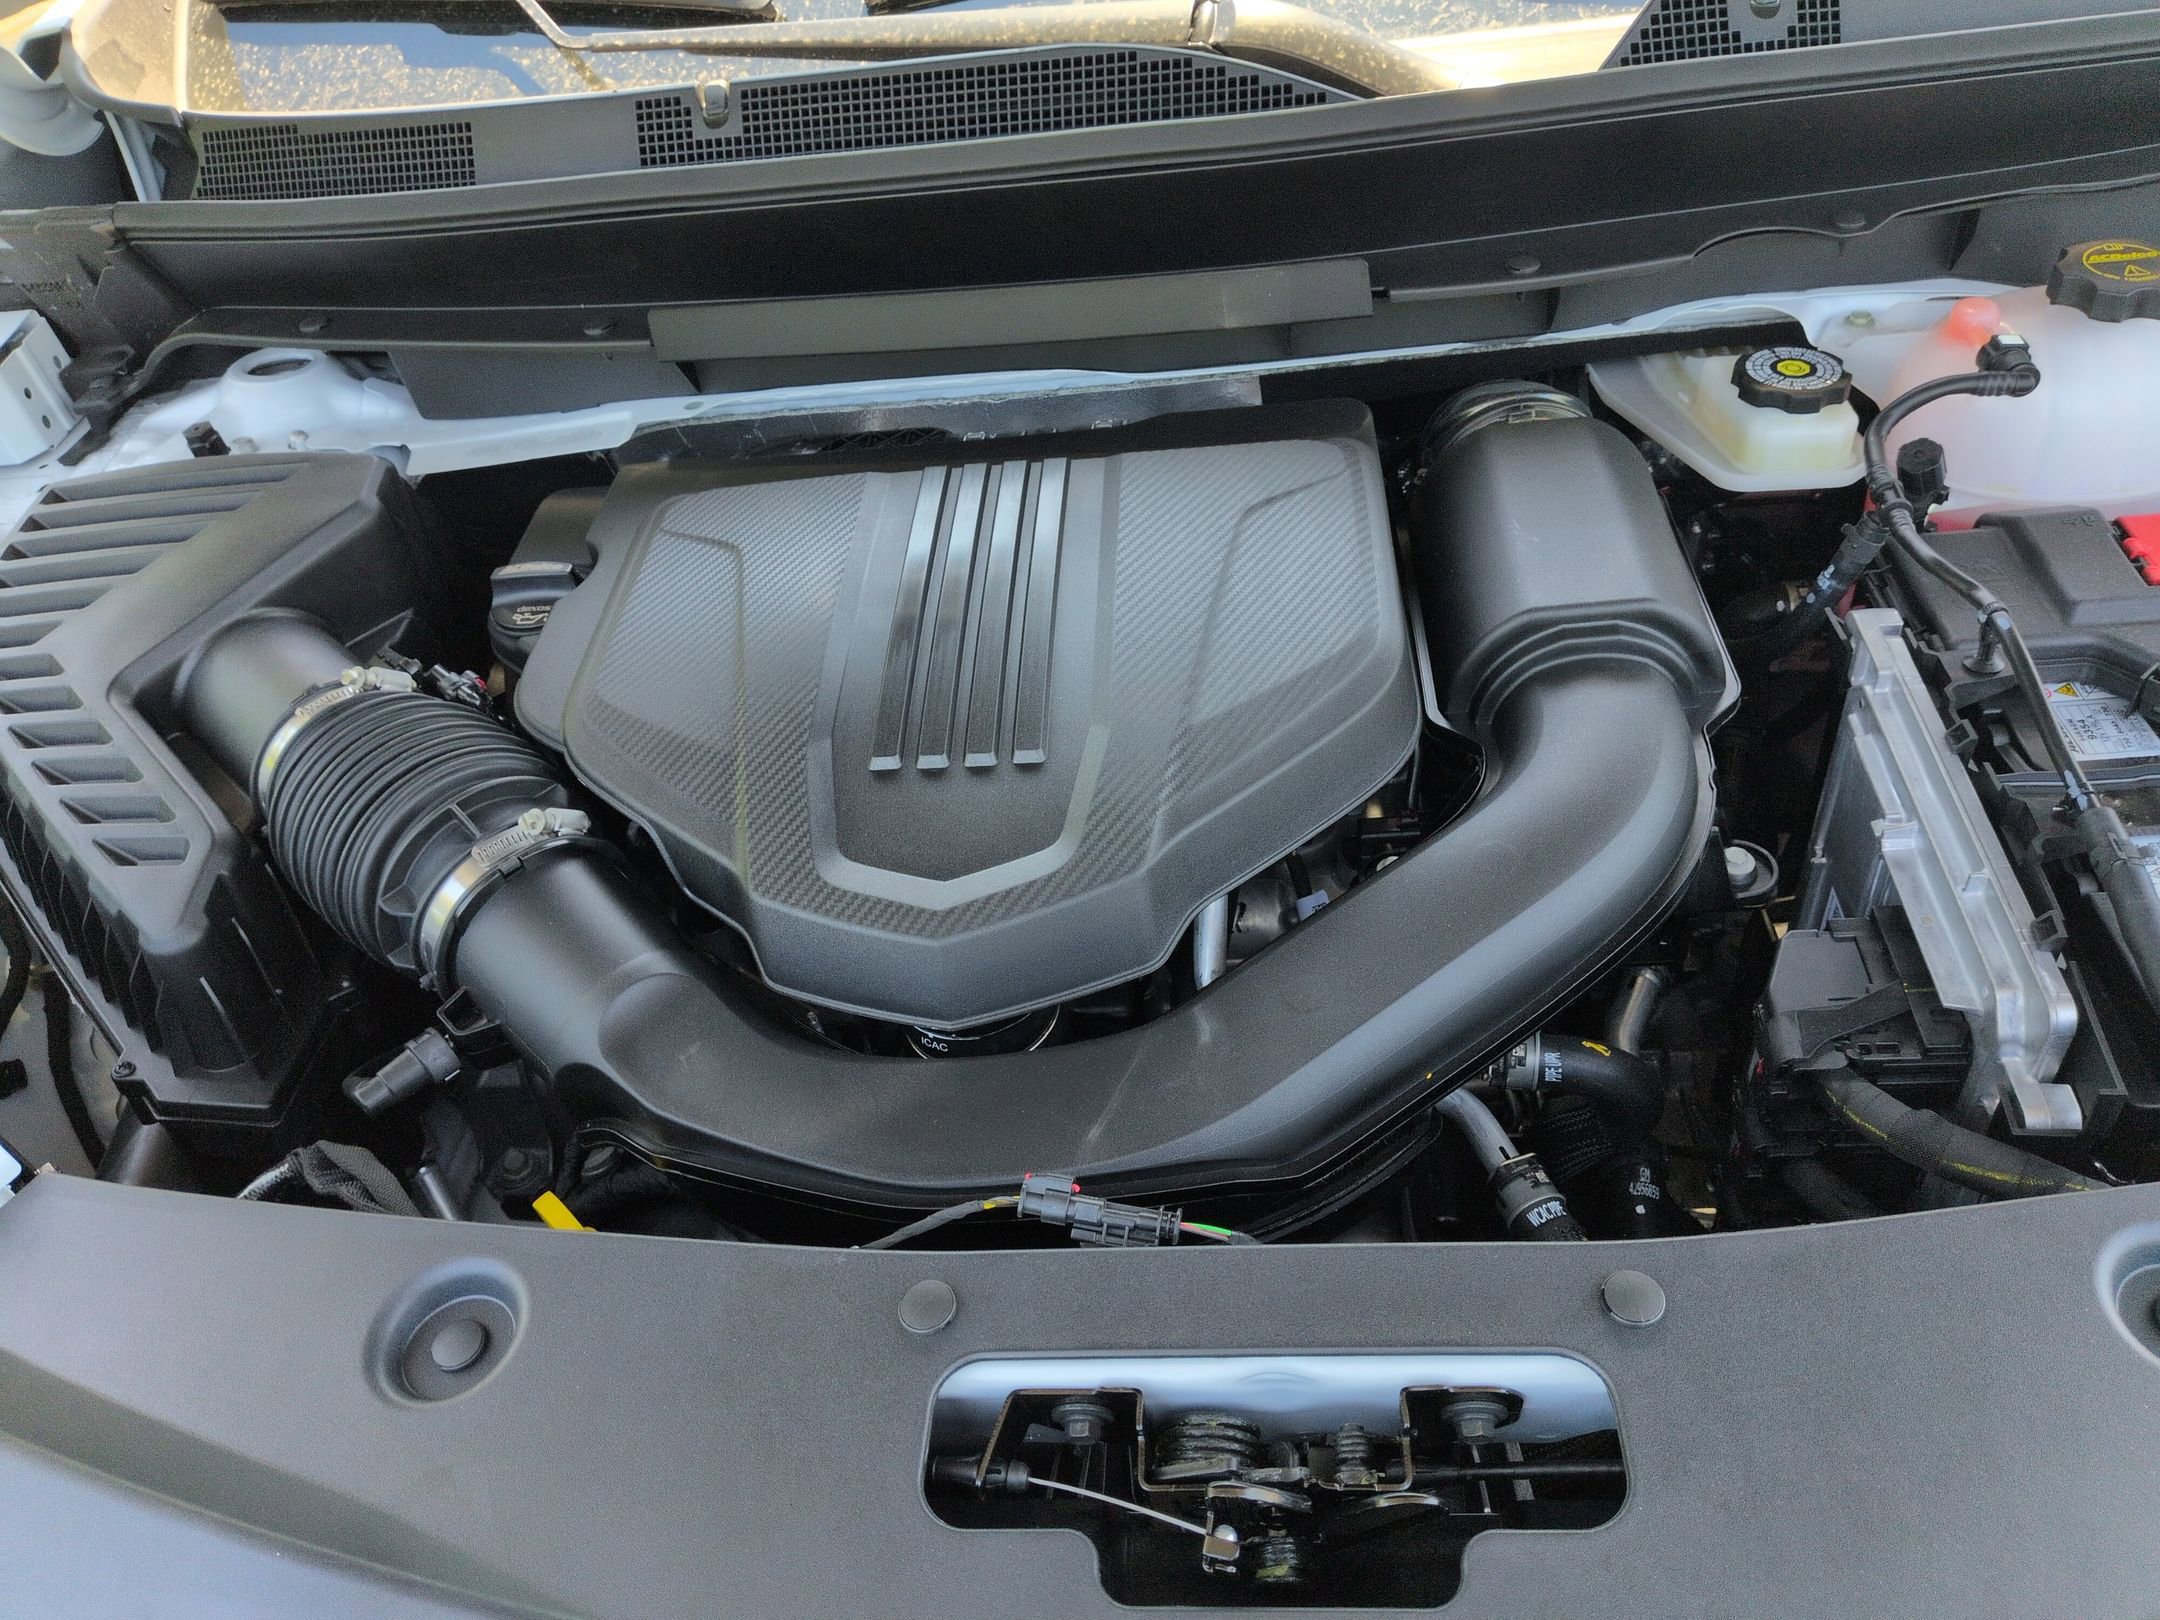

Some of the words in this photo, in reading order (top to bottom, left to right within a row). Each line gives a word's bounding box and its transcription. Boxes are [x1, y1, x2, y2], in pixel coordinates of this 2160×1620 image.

[921, 1036, 949, 1051] ICAC
[1544, 1052, 1562, 1066] UPR
[1544, 1067, 1562, 1082] PIPE
[1639, 1167, 1651, 1183] GM
